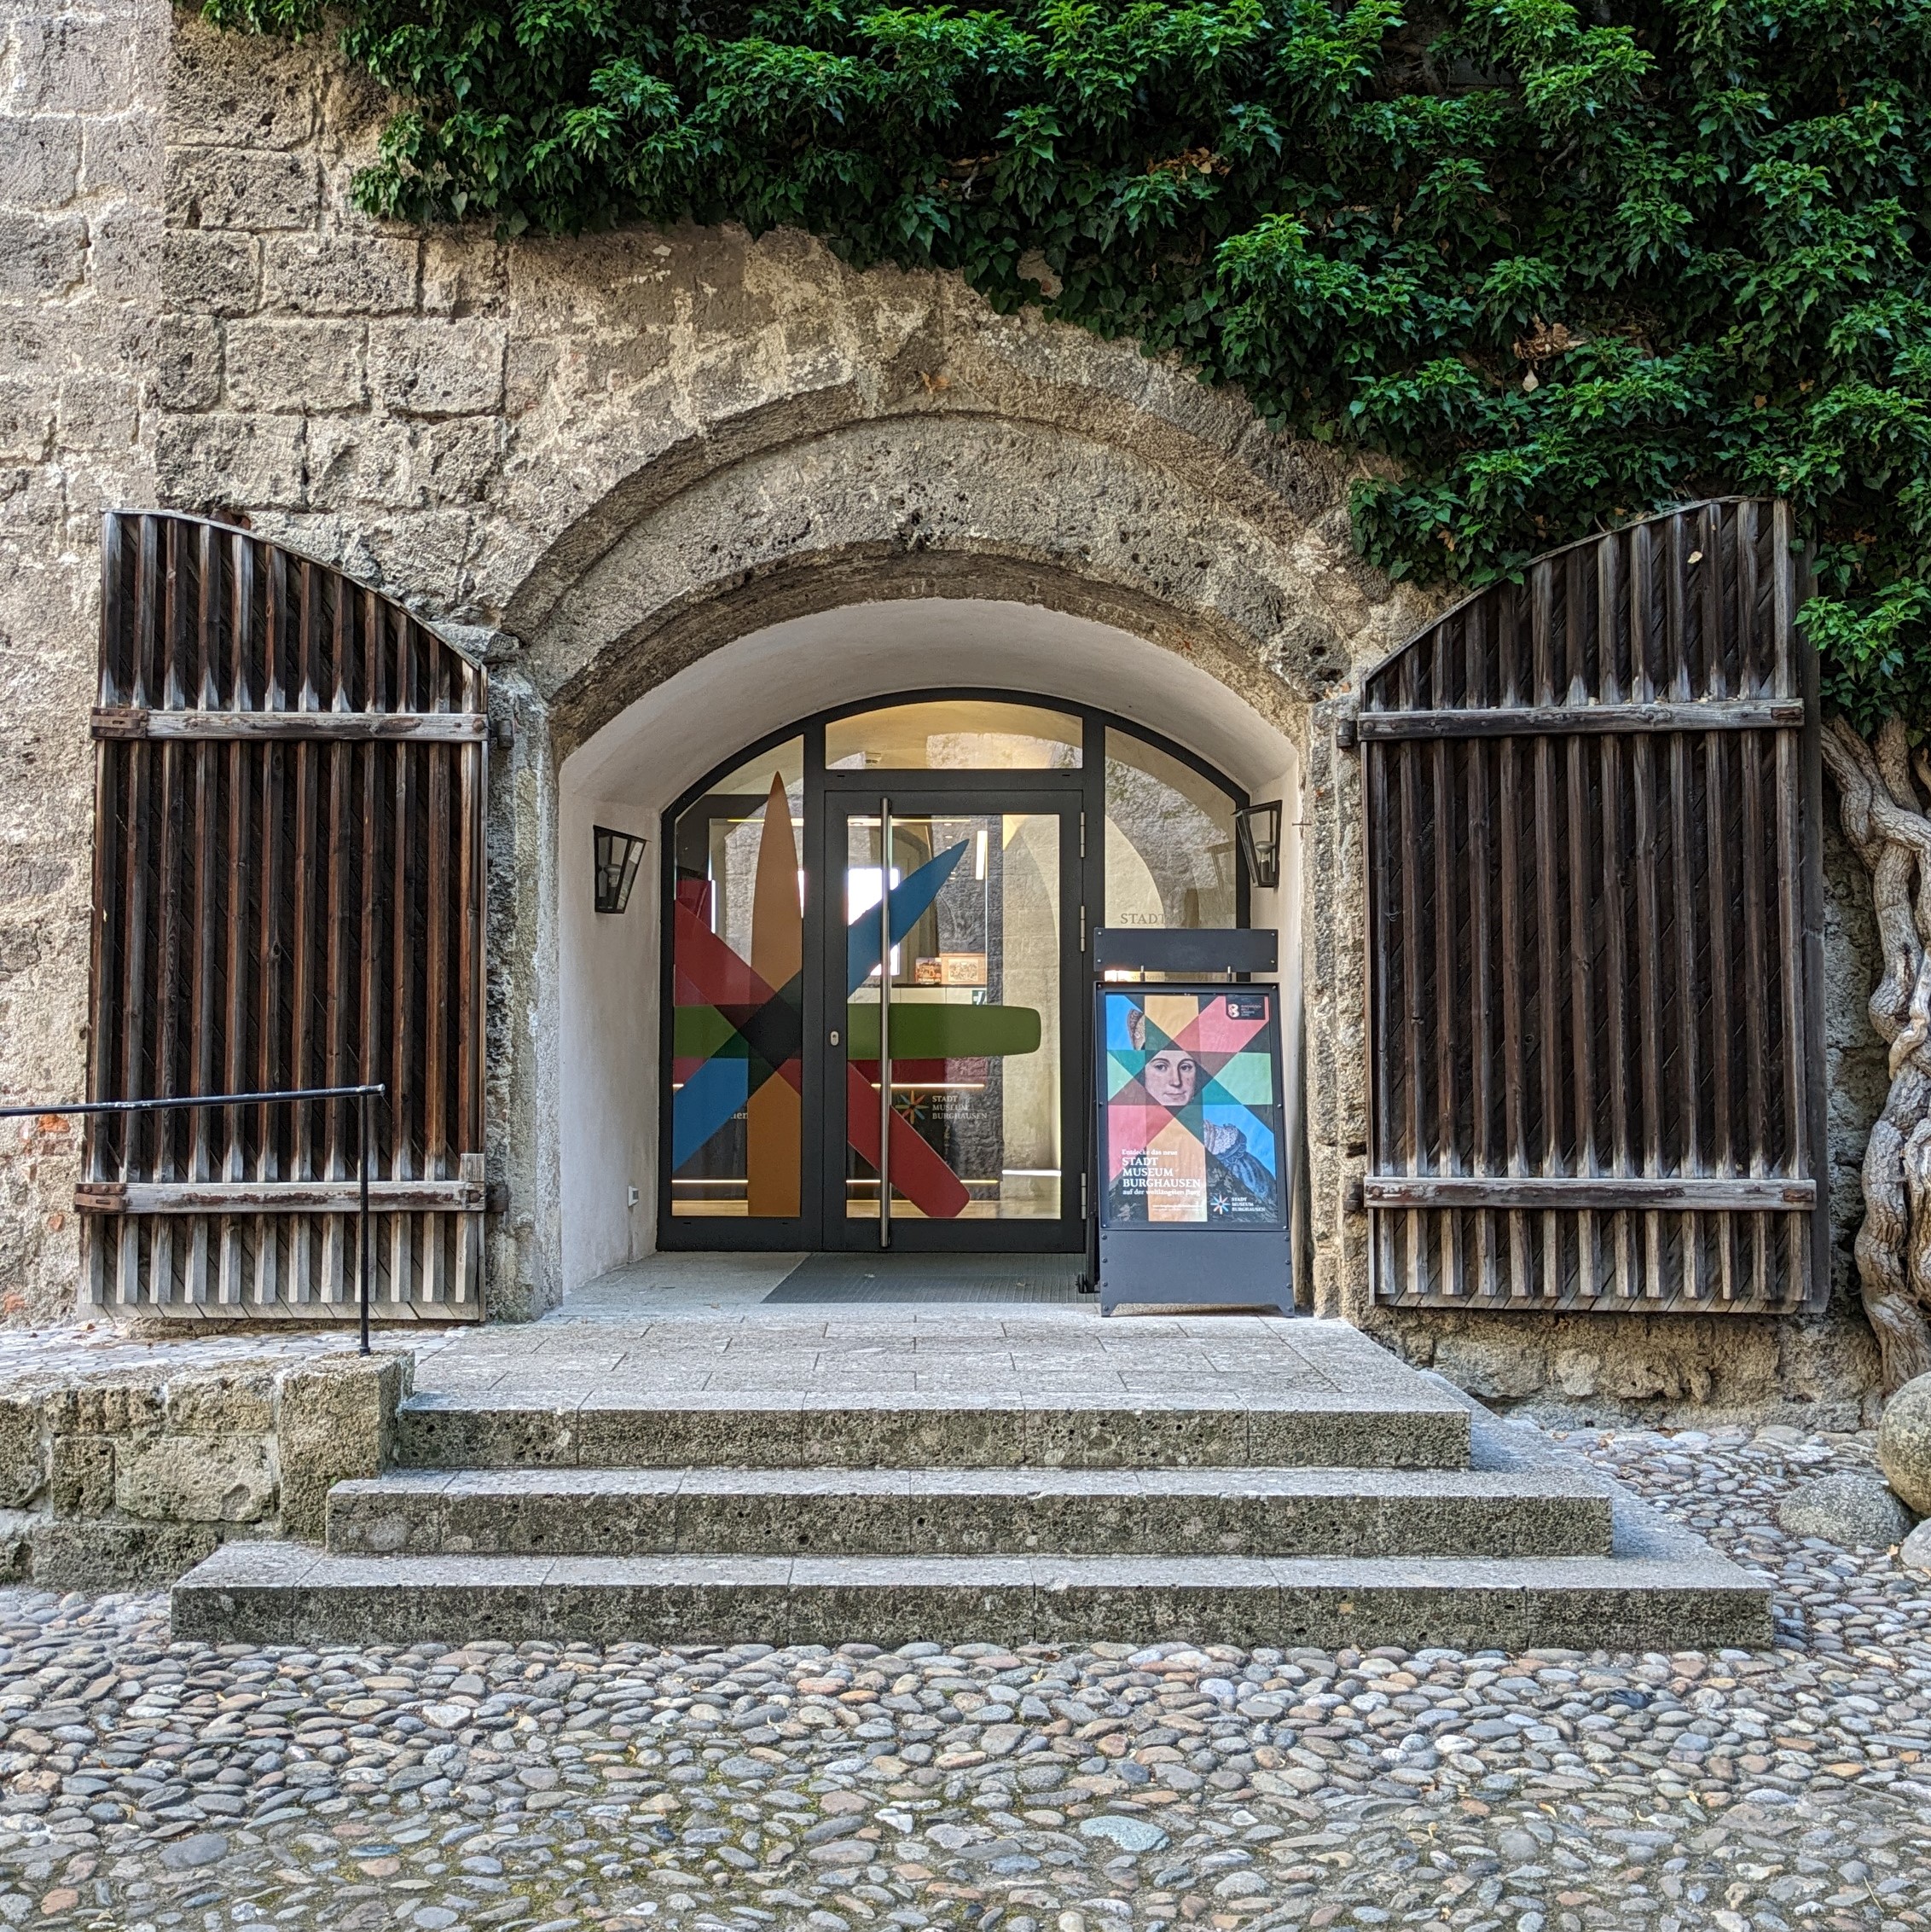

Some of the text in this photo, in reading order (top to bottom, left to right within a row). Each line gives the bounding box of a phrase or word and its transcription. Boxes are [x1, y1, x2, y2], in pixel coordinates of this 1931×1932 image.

[1122, 1157, 1158, 1166] STADT
[1122, 1167, 1174, 1177] MUSEUM
[1122, 1178, 1201, 1187] BURGHAUSEN
